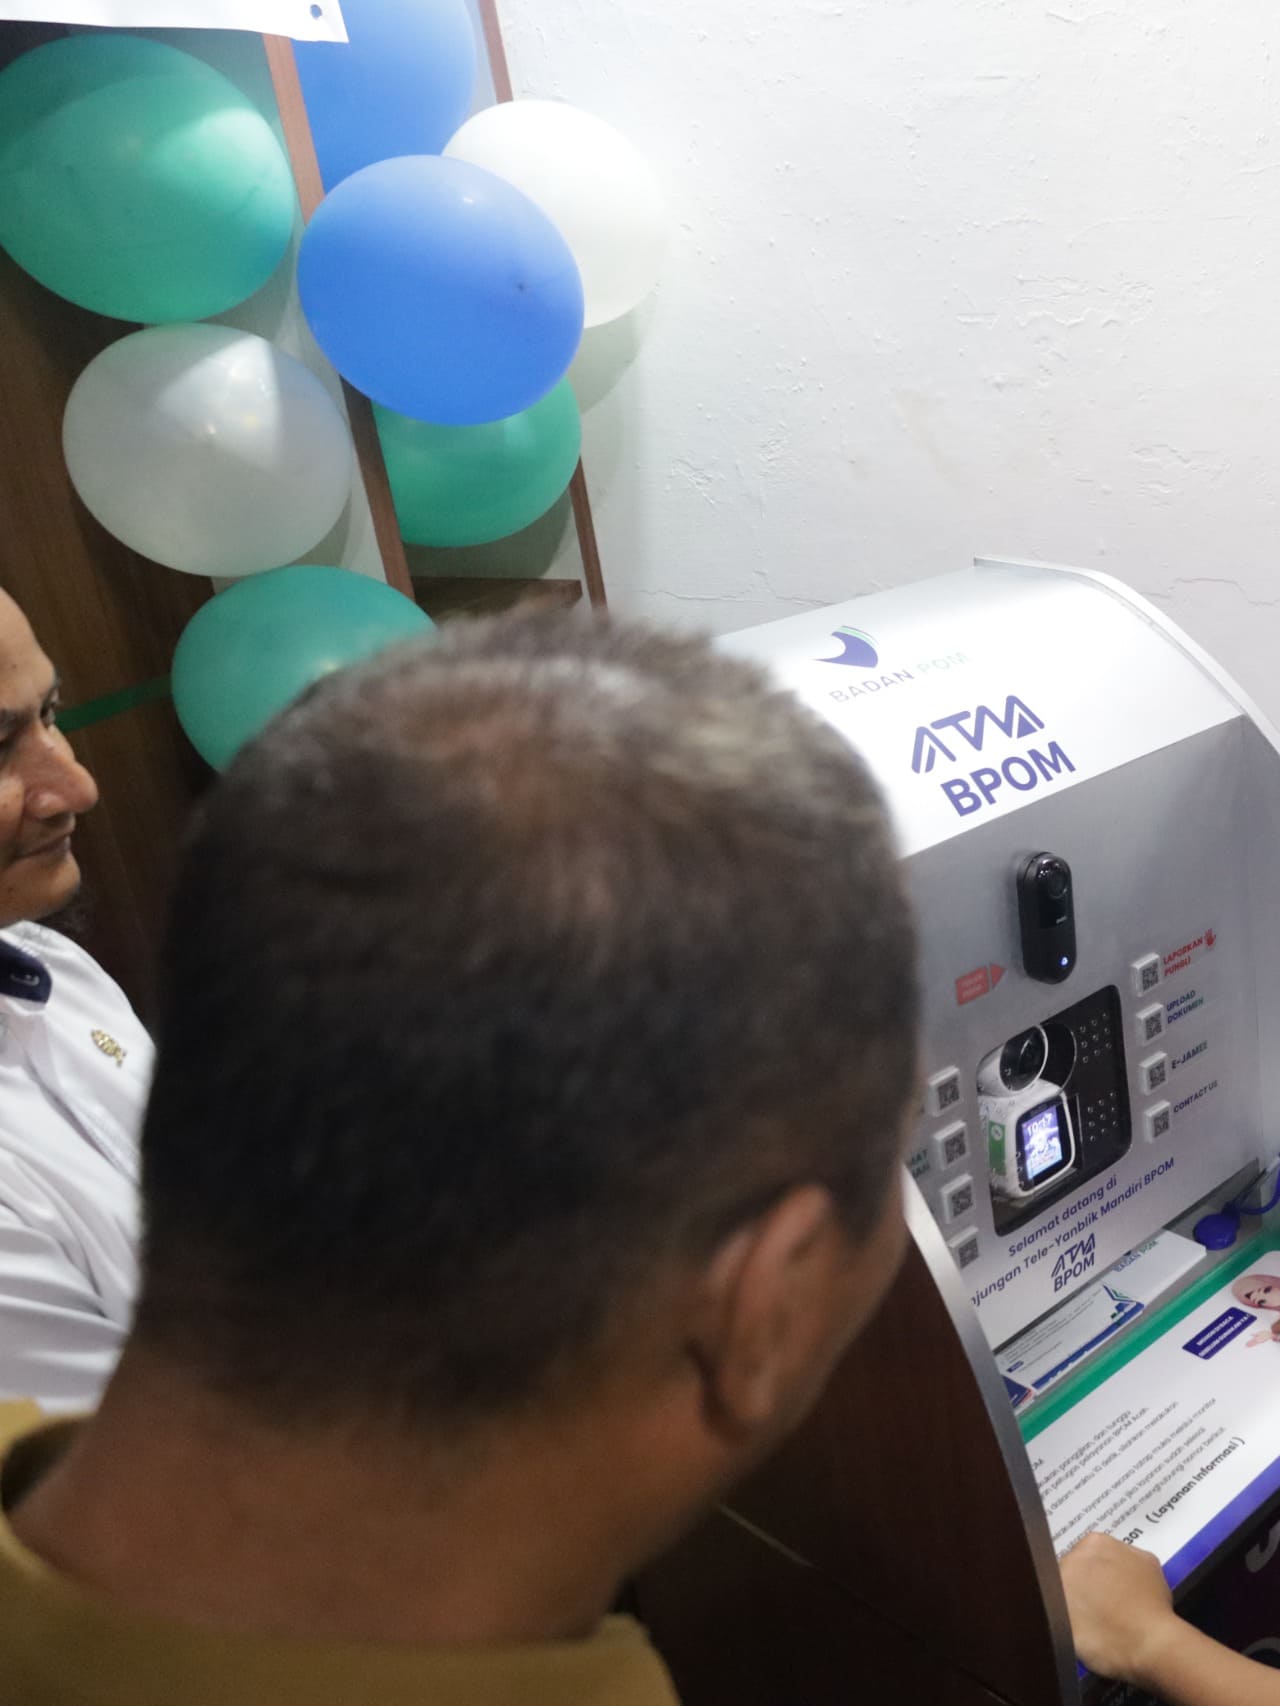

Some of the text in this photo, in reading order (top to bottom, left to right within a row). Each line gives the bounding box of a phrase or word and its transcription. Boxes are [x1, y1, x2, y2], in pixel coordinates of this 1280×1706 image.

[828, 652, 972, 703] BADAN POM
[911, 695, 1045, 774] ATM
[940, 741, 1076, 817] BPOM
[1166, 990, 1196, 1012] UPLOAD
[1167, 998, 1204, 1025] DOKUMEN
[1173, 1085, 1208, 1113] CONTACT
[971, 1157, 1176, 1307] njungan Tele-Yanblik Mandiri BPOM
[1008, 1174, 1118, 1257] Selamat datang di
[1051, 1233, 1096, 1278] ATM
[1053, 1252, 1096, 1293] BPOM
